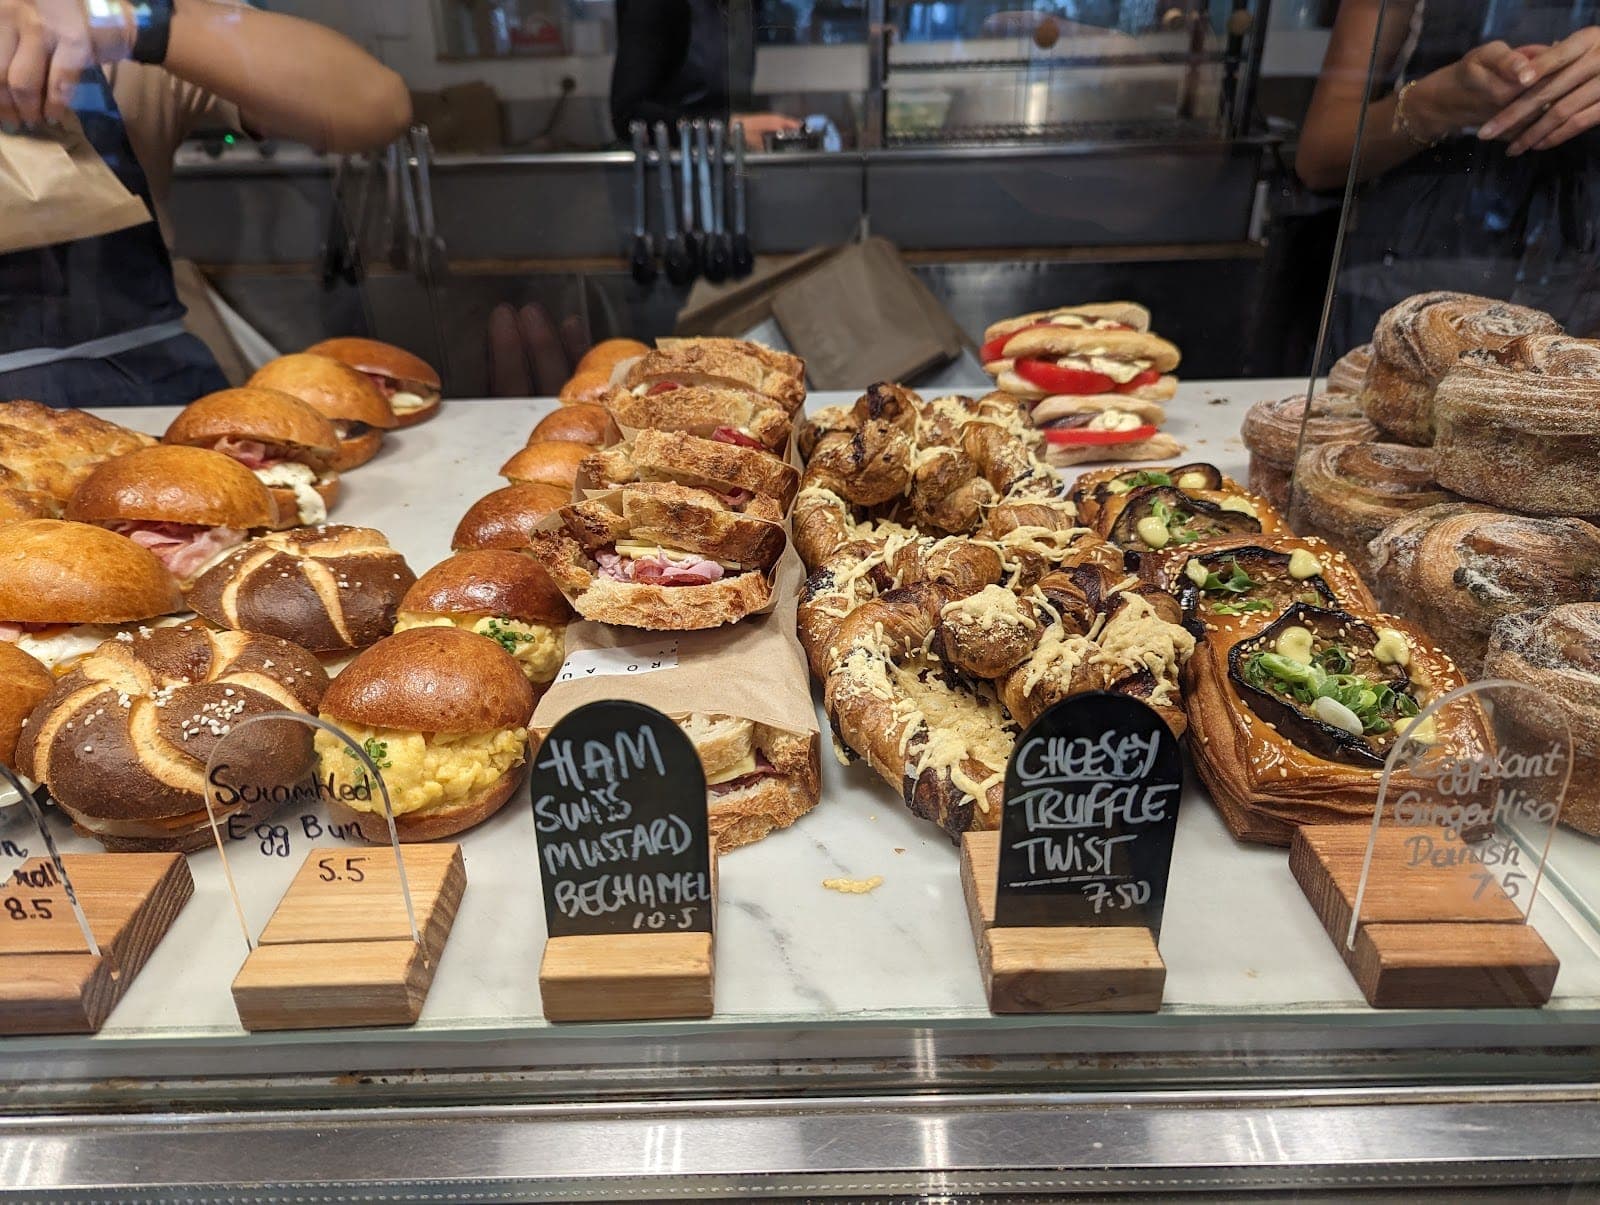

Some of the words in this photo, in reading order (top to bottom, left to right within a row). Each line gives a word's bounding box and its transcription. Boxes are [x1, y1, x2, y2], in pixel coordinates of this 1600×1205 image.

[538, 725, 666, 792] HAM
[209, 764, 372, 805] Scrambled
[1007, 782, 1180, 832] TRUFFLE
[228, 814, 290, 857] Egg
[301, 814, 370, 842] Bun
[543, 814, 692, 875] MUSTARD
[1404, 834, 1520, 868] Danish
[319, 857, 371, 882] 5.5
[4, 897, 53, 921] 8.5
[554, 872, 710, 918] BECHAMEL
[1082, 881, 1152, 914] 7.50
